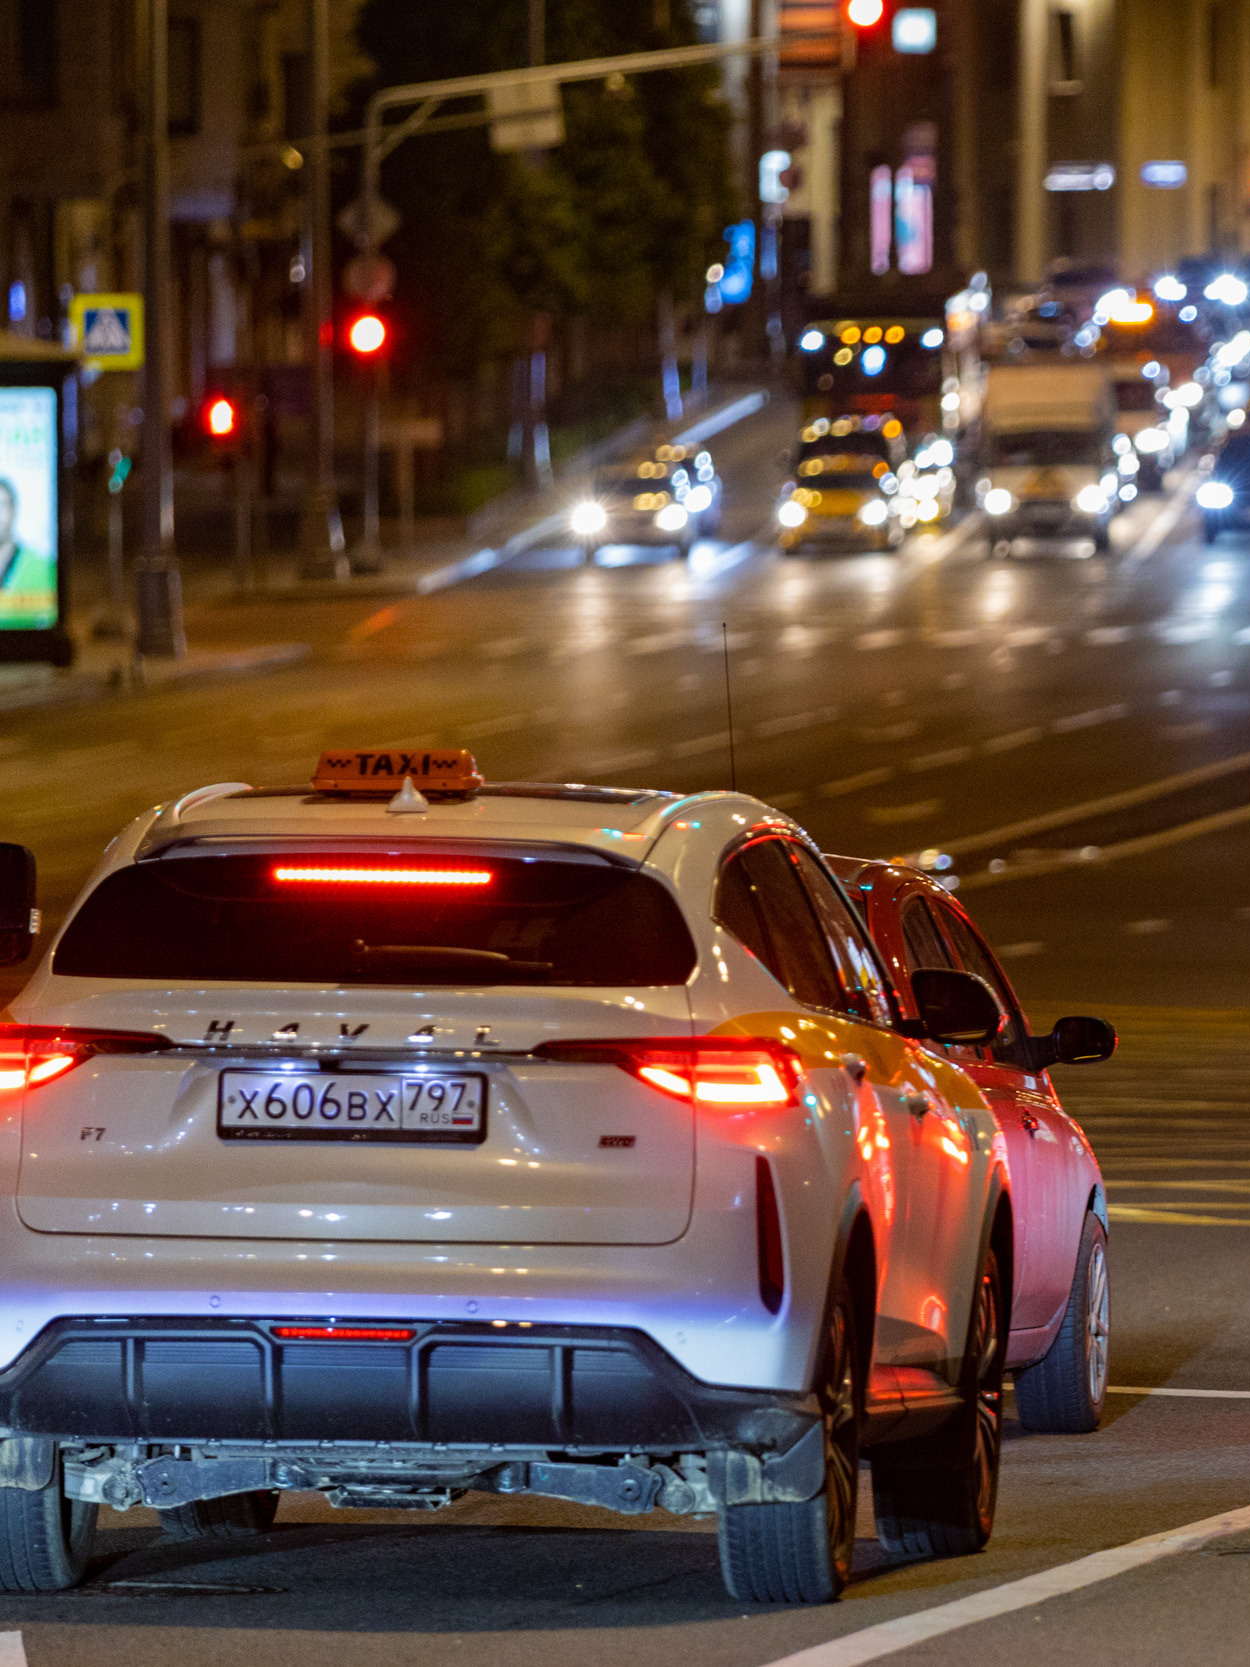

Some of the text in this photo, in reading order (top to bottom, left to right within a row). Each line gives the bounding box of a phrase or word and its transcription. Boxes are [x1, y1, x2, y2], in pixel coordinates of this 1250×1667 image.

[356, 754, 431, 776] TAXI
[203, 1020, 501, 1046] HAVAL
[406, 1081, 467, 1112] 797
[419, 1112, 450, 1125] RUS
[80, 1126, 107, 1141] F7
